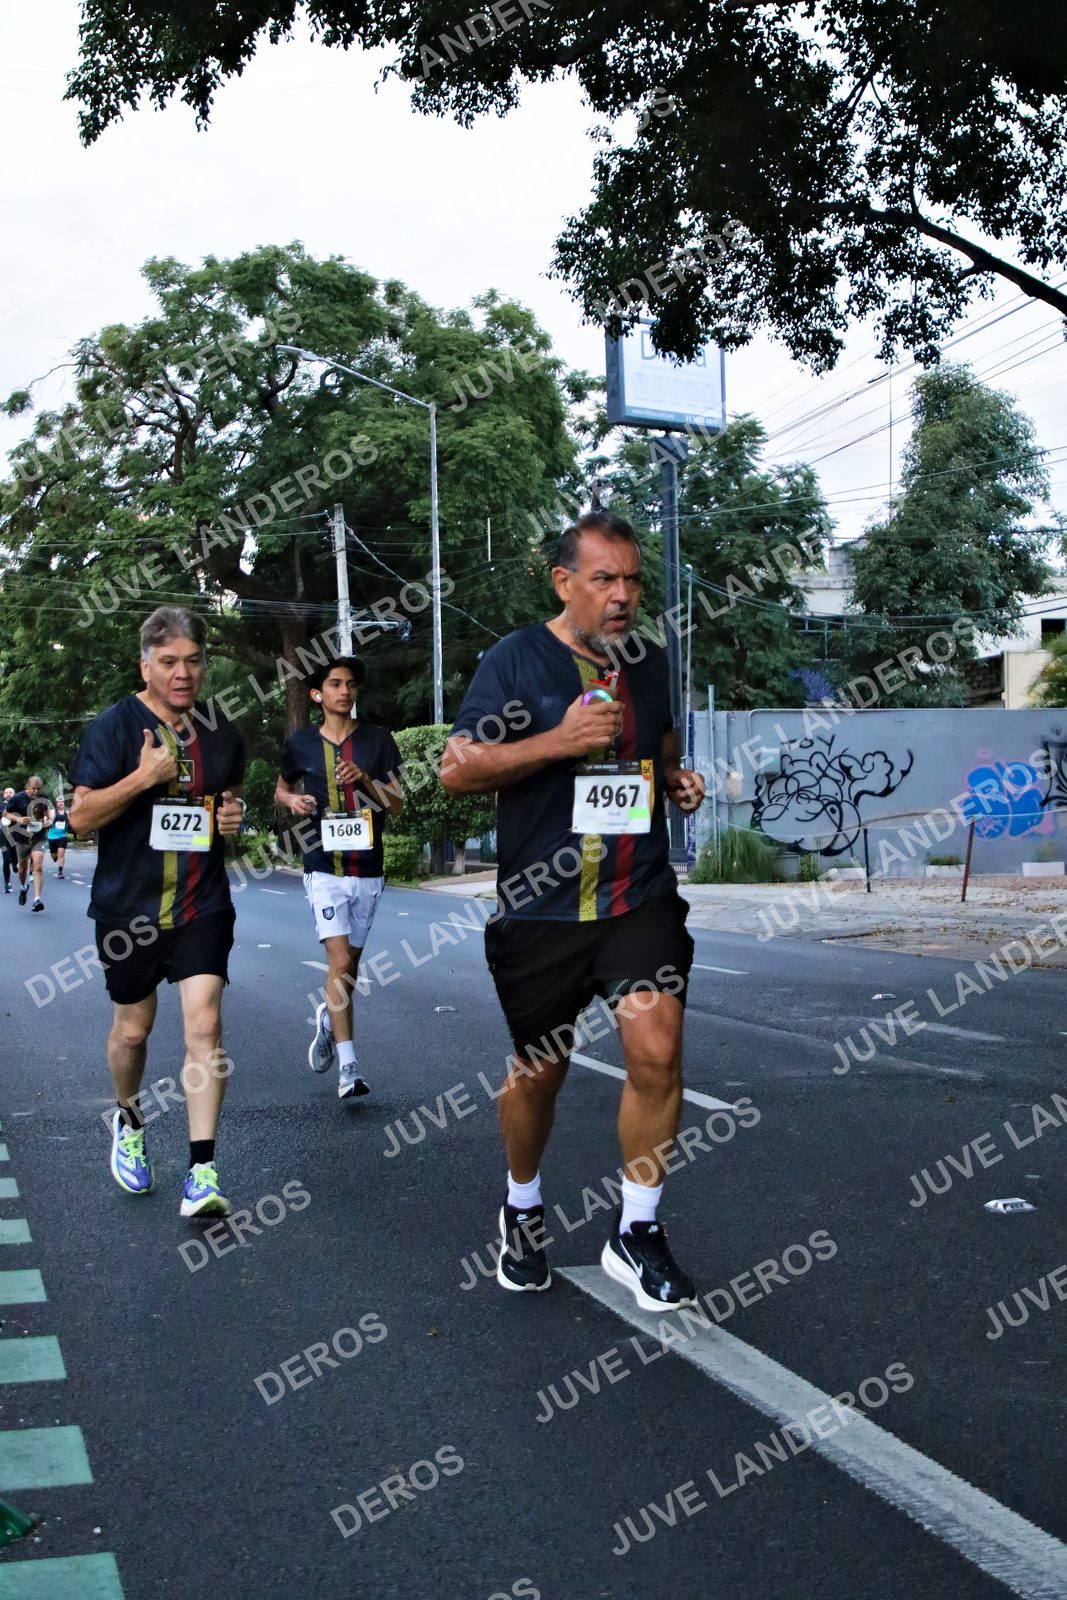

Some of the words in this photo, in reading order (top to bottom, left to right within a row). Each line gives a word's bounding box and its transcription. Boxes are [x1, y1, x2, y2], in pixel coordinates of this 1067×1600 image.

[586, 784, 640, 808] 4967
[161, 813, 202, 832] 6272
[329, 823, 362, 837] 1608
